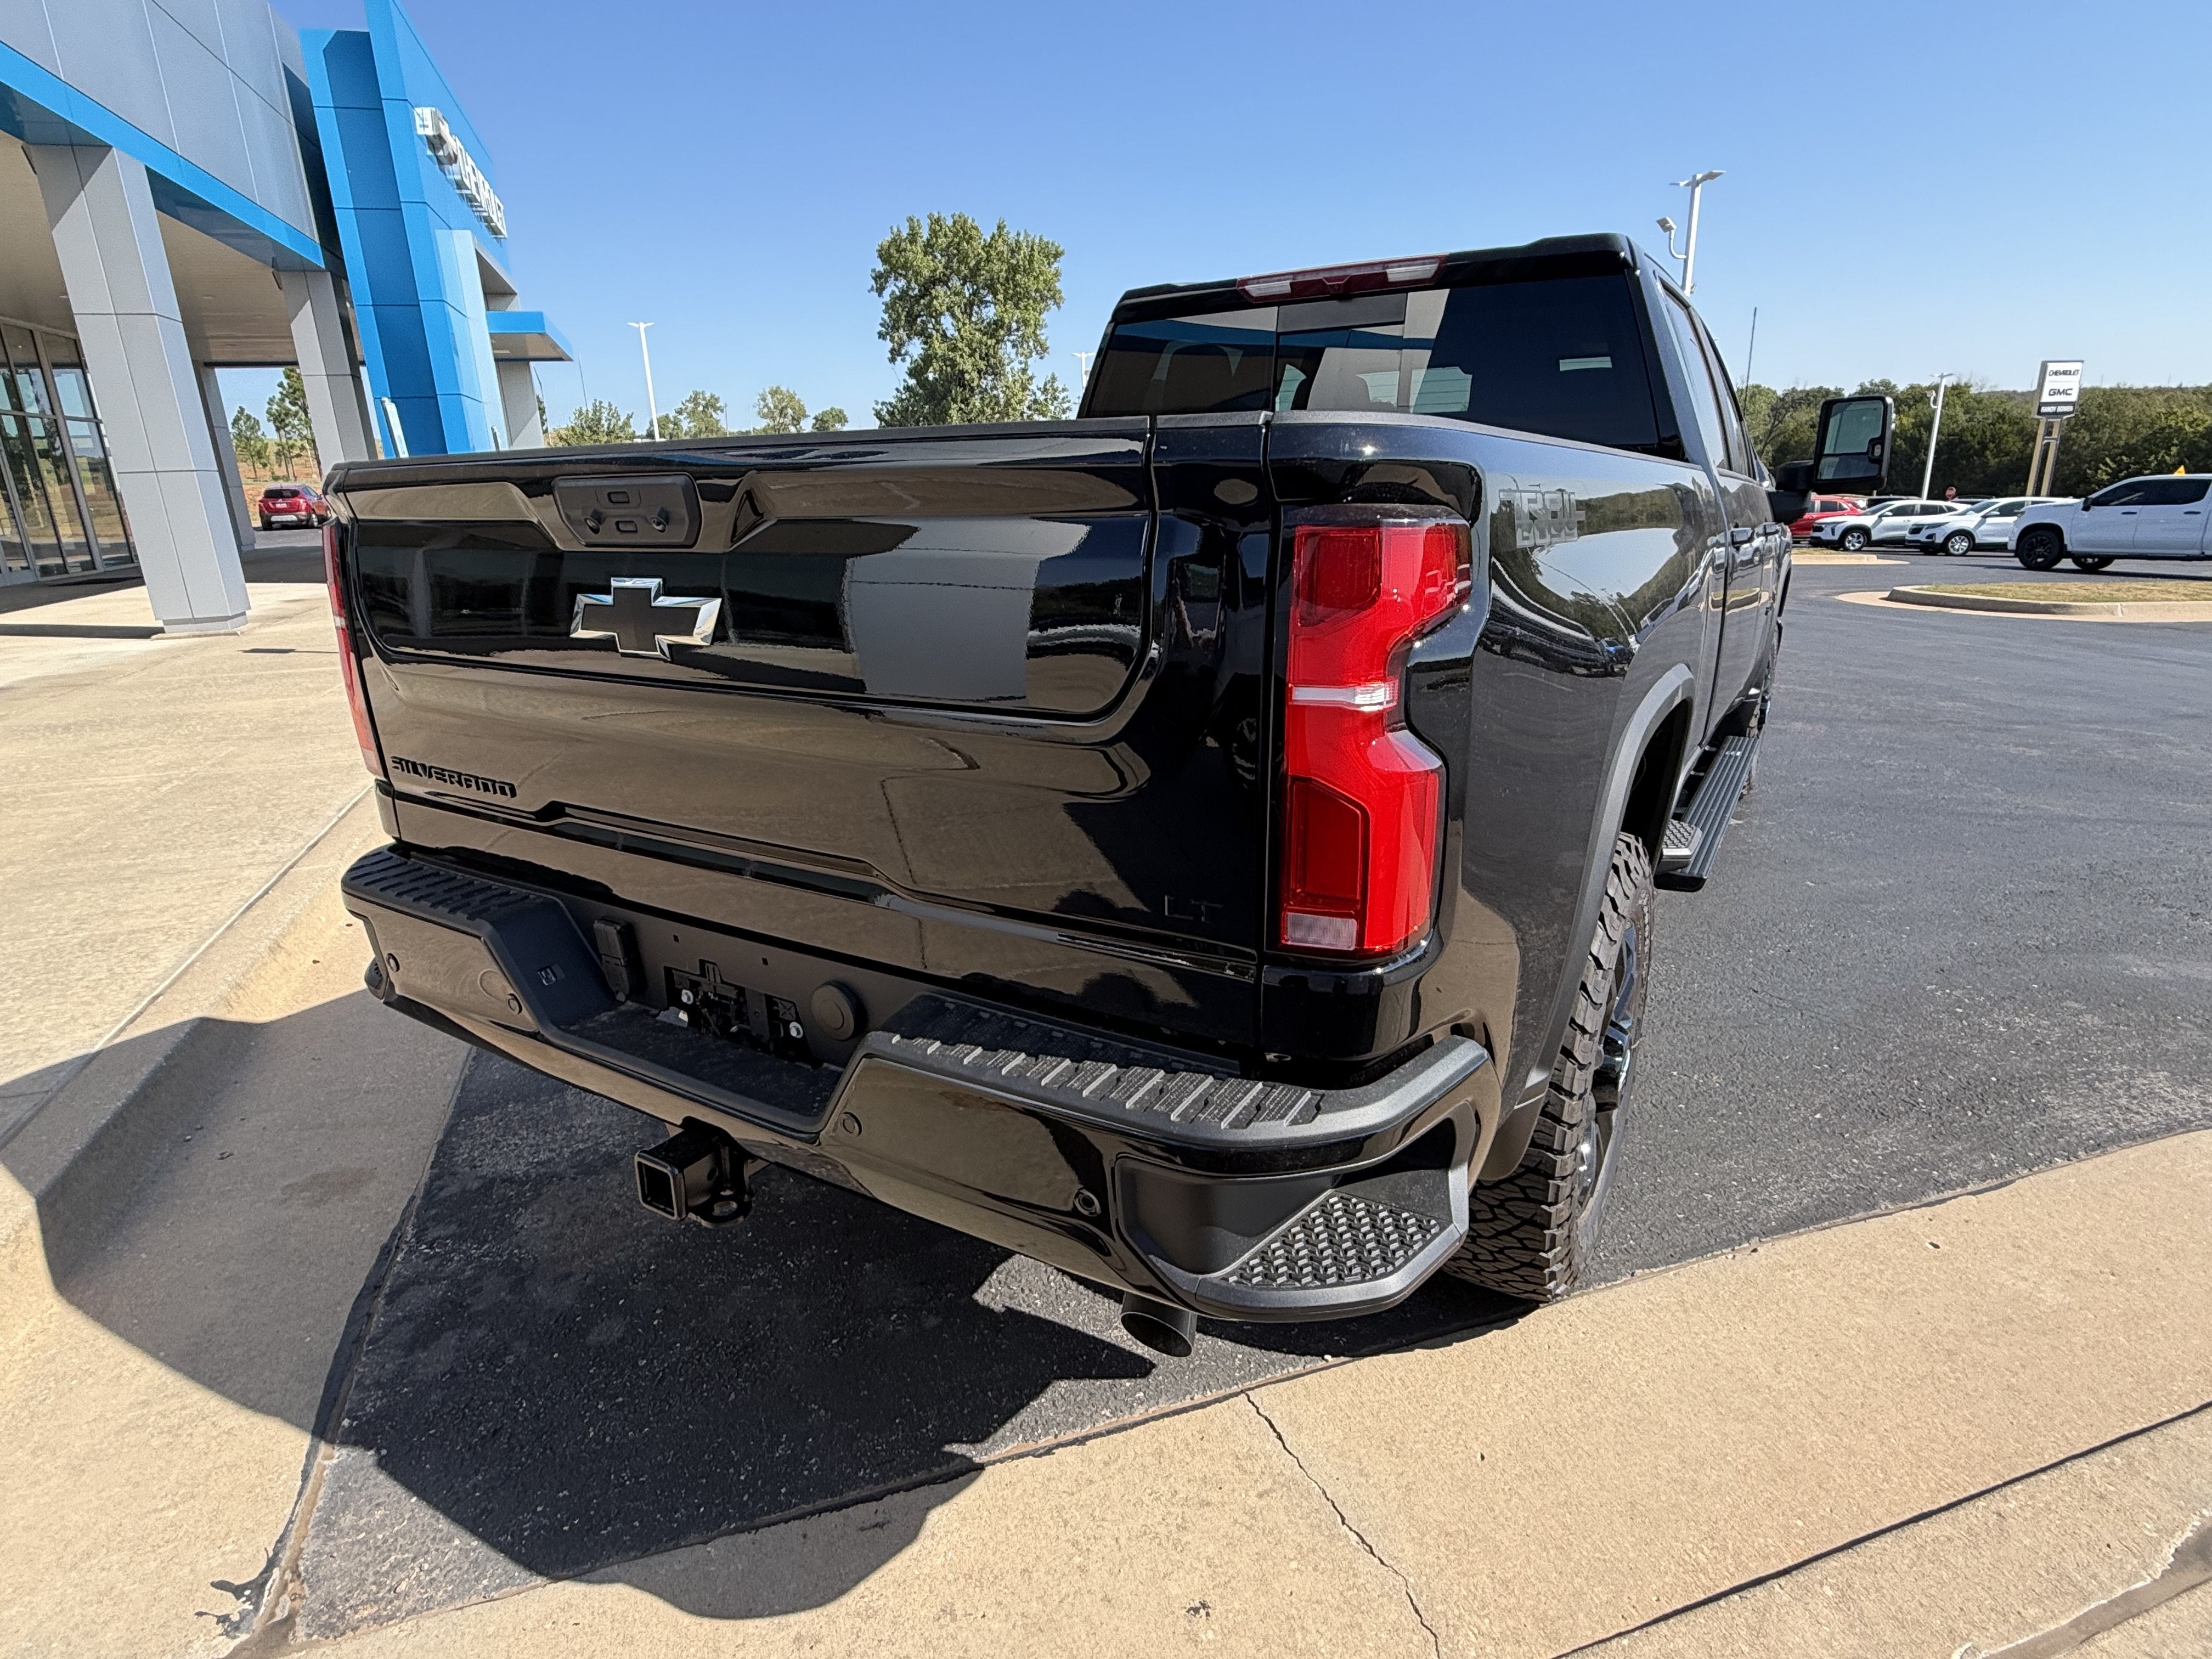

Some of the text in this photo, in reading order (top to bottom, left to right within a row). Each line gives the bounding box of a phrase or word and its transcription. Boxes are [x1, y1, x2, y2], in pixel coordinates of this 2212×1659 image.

[2048, 388, 2073, 396] GMC
[1499, 489, 1586, 521] TRAIL
[1516, 520, 1578, 549] BOSS
[391, 756, 517, 799] SILVERADO
[1164, 894, 1223, 923] LT
